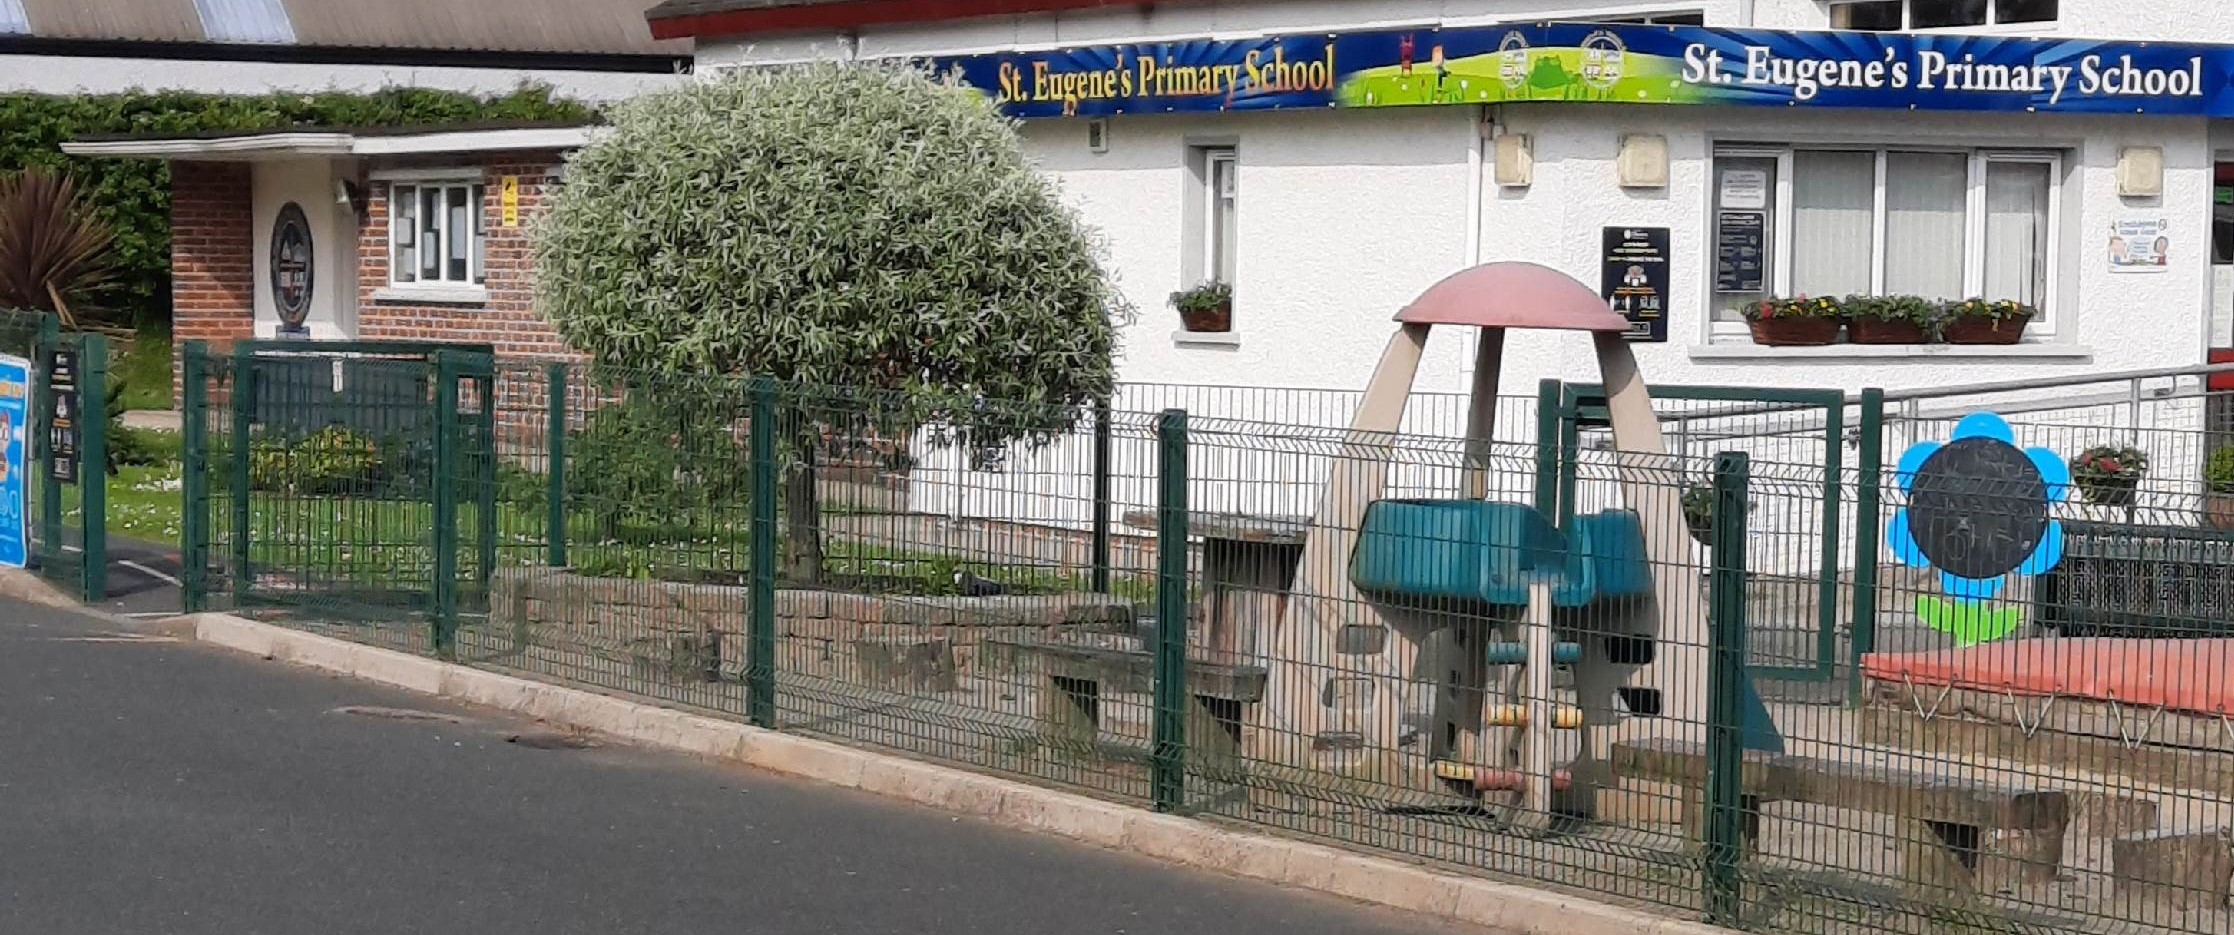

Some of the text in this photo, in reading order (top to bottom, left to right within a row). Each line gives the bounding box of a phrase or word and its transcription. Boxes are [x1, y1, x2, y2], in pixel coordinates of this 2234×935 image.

[999, 43, 1335, 116] St. Eugene's Primary School
[1682, 43, 2203, 105] St. Eugene's Primary School
